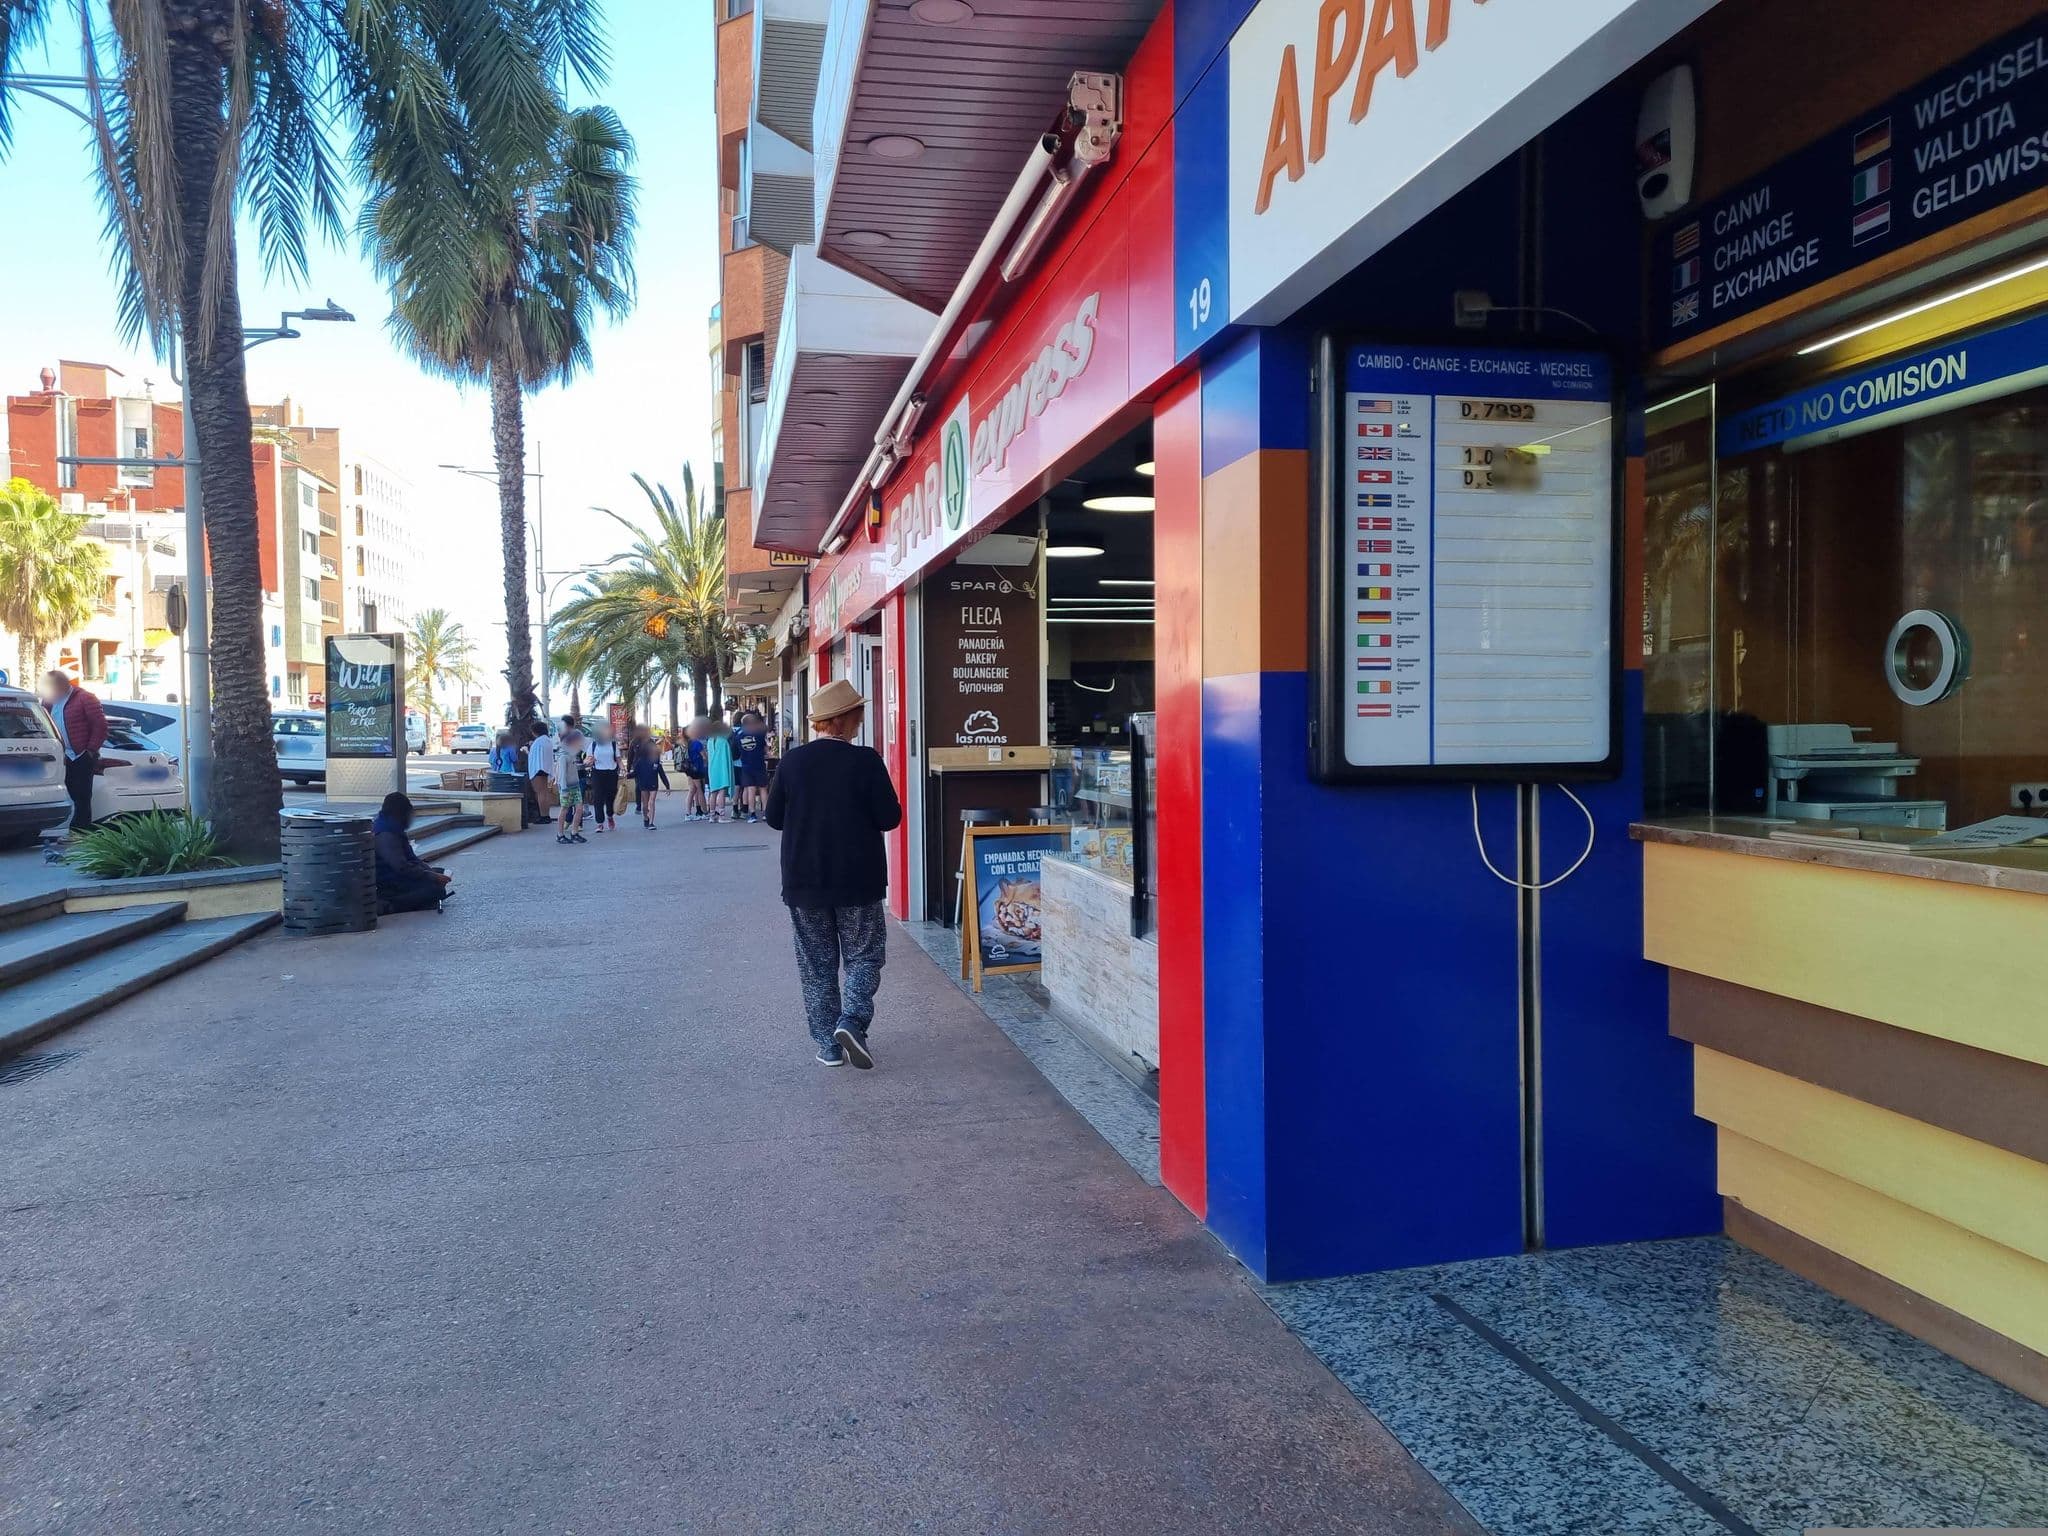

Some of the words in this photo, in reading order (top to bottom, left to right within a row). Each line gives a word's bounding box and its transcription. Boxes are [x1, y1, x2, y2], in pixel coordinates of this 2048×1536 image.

[1914, 36, 2048, 130] WECHSEL
[1914, 101, 2016, 174] VALUTA
[1713, 185, 1771, 236] CANVI
[1713, 211, 1794, 271] CHANGE
[1712, 238, 1820, 309] EXCHANGE
[1189, 278, 1211, 331] 19
[1358, 354, 1403, 369] CAMBIO
[1412, 356, 1460, 372] CHANGE
[1470, 359, 1531, 375] EXCHANGE
[1541, 362, 1593, 377] WECHSEL
[1740, 404, 1796, 441] NETO
[1802, 393, 1834, 425] NO
[1839, 350, 1967, 415] COMISION
[889, 461, 942, 567] SPAR
[972, 291, 1100, 478] express
[950, 581, 996, 591] SPAR
[961, 606, 1002, 625] FLECA
[958, 636, 1005, 650] PANADERÍA
[965, 653, 997, 665] BAKERY
[338, 660, 382, 690] Wild
[953, 667, 1009, 679] BOULANGERIE
[959, 681, 1004, 695] Булочная
[956, 733, 973, 744] las
[975, 734, 1007, 744] muns
[984, 851, 1026, 865] EMPANADAS
[991, 864, 1006, 875] CON
[1007, 863, 1016, 874] EL
[1018, 861, 1041, 873] CORAZ
